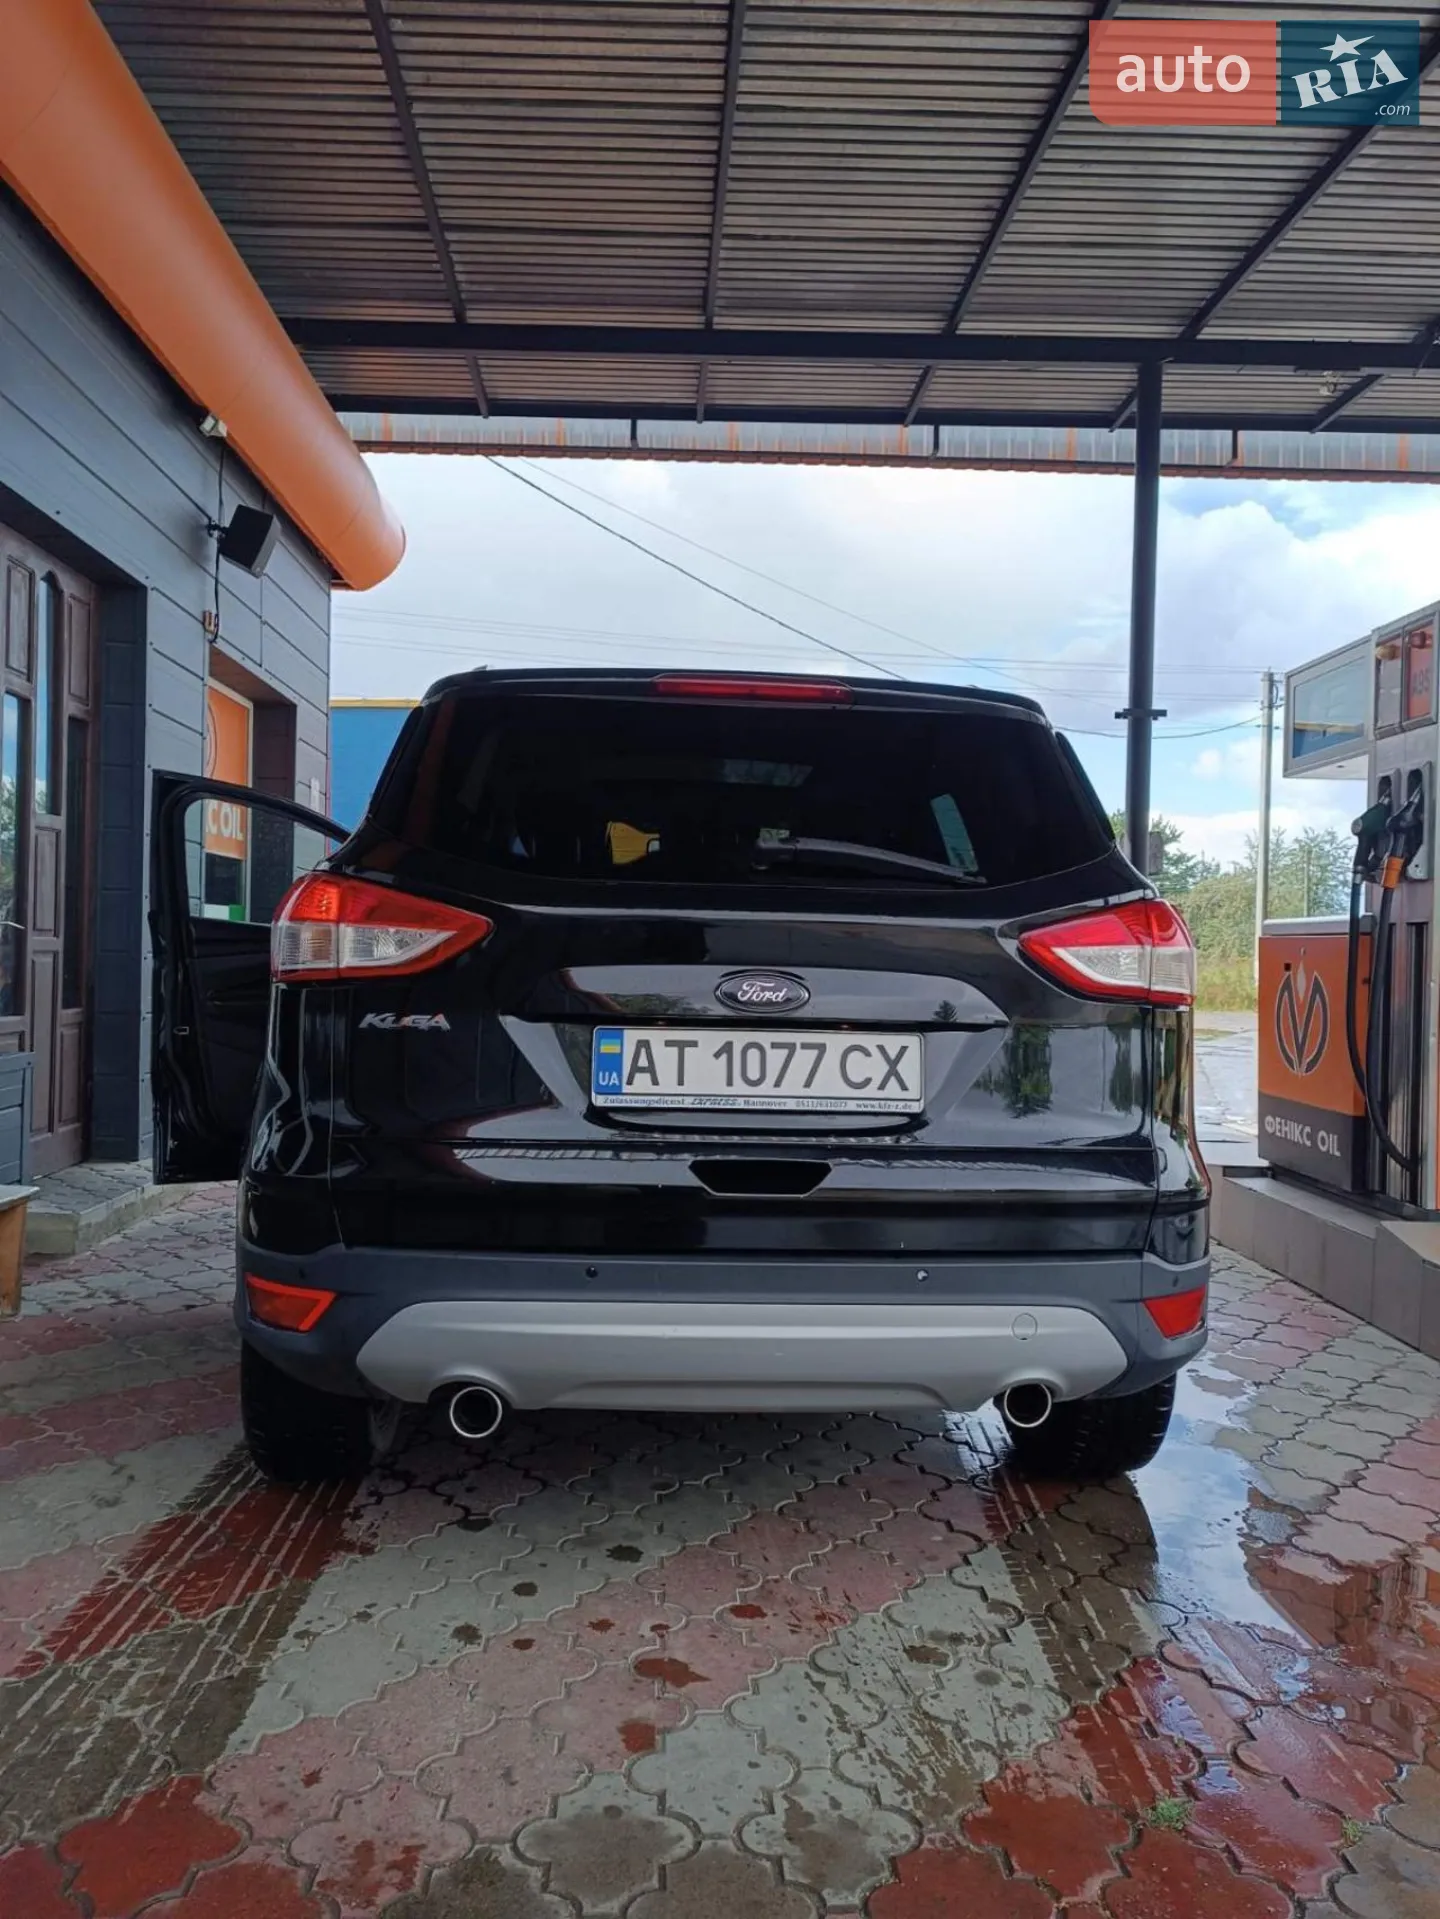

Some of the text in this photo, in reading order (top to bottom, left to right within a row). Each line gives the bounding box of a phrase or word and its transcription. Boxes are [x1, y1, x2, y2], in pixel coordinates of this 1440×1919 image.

[219, 802, 244, 841] OIL
[737, 980, 788, 1002] Ford
[358, 1012, 451, 1031] KUGA
[598, 1071, 620, 1087] UA
[625, 1039, 909, 1092] AT 1077 CX
[1264, 1114, 1341, 1157] ФЕНІКС OIL
